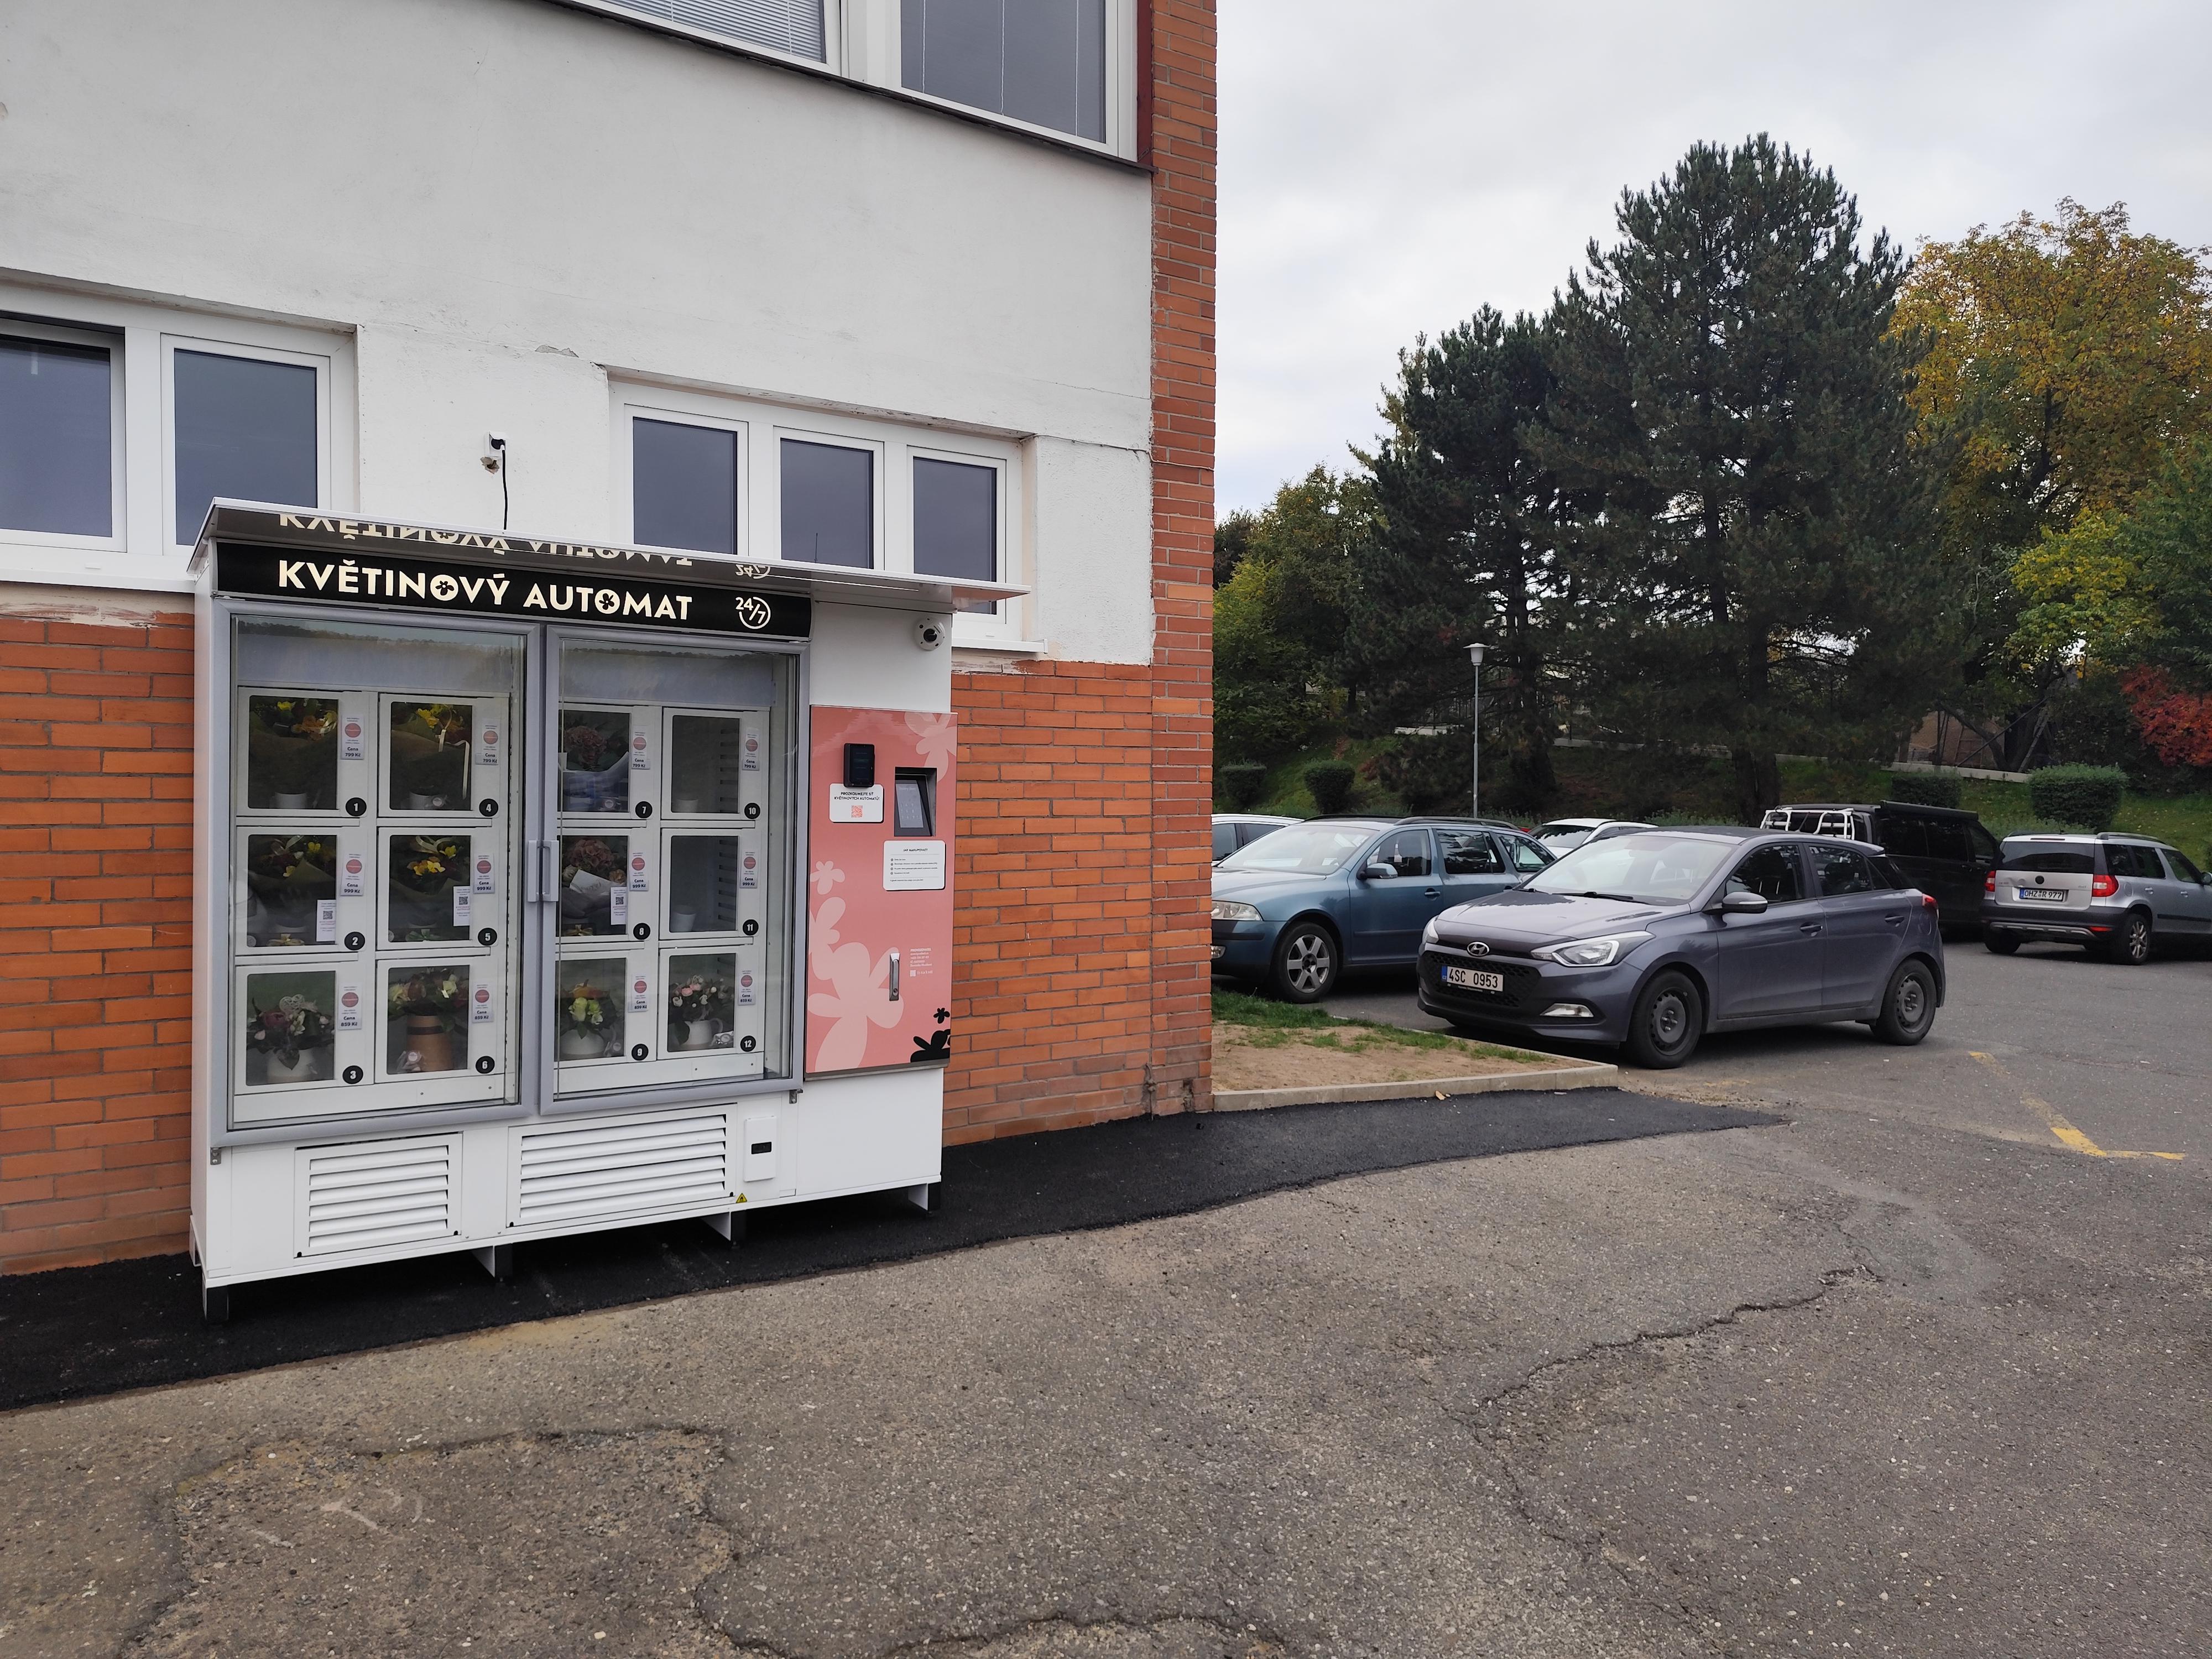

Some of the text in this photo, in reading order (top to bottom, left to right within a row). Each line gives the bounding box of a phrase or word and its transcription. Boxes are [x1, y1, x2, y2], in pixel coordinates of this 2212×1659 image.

[279, 559, 692, 620] KVĚTINOVÝ AUTOMAT
[735, 597, 766, 624] 24/7
[353, 803, 358, 811] 1
[486, 804, 491, 812] 4
[352, 937, 358, 945] 2
[485, 933, 491, 941] 5
[1449, 968, 1498, 988] 4SC 0953
[744, 1040, 752, 1048] 12
[637, 1048, 643, 1056] 9
[482, 1061, 488, 1070] 6
[349, 1071, 356, 1079] 3
